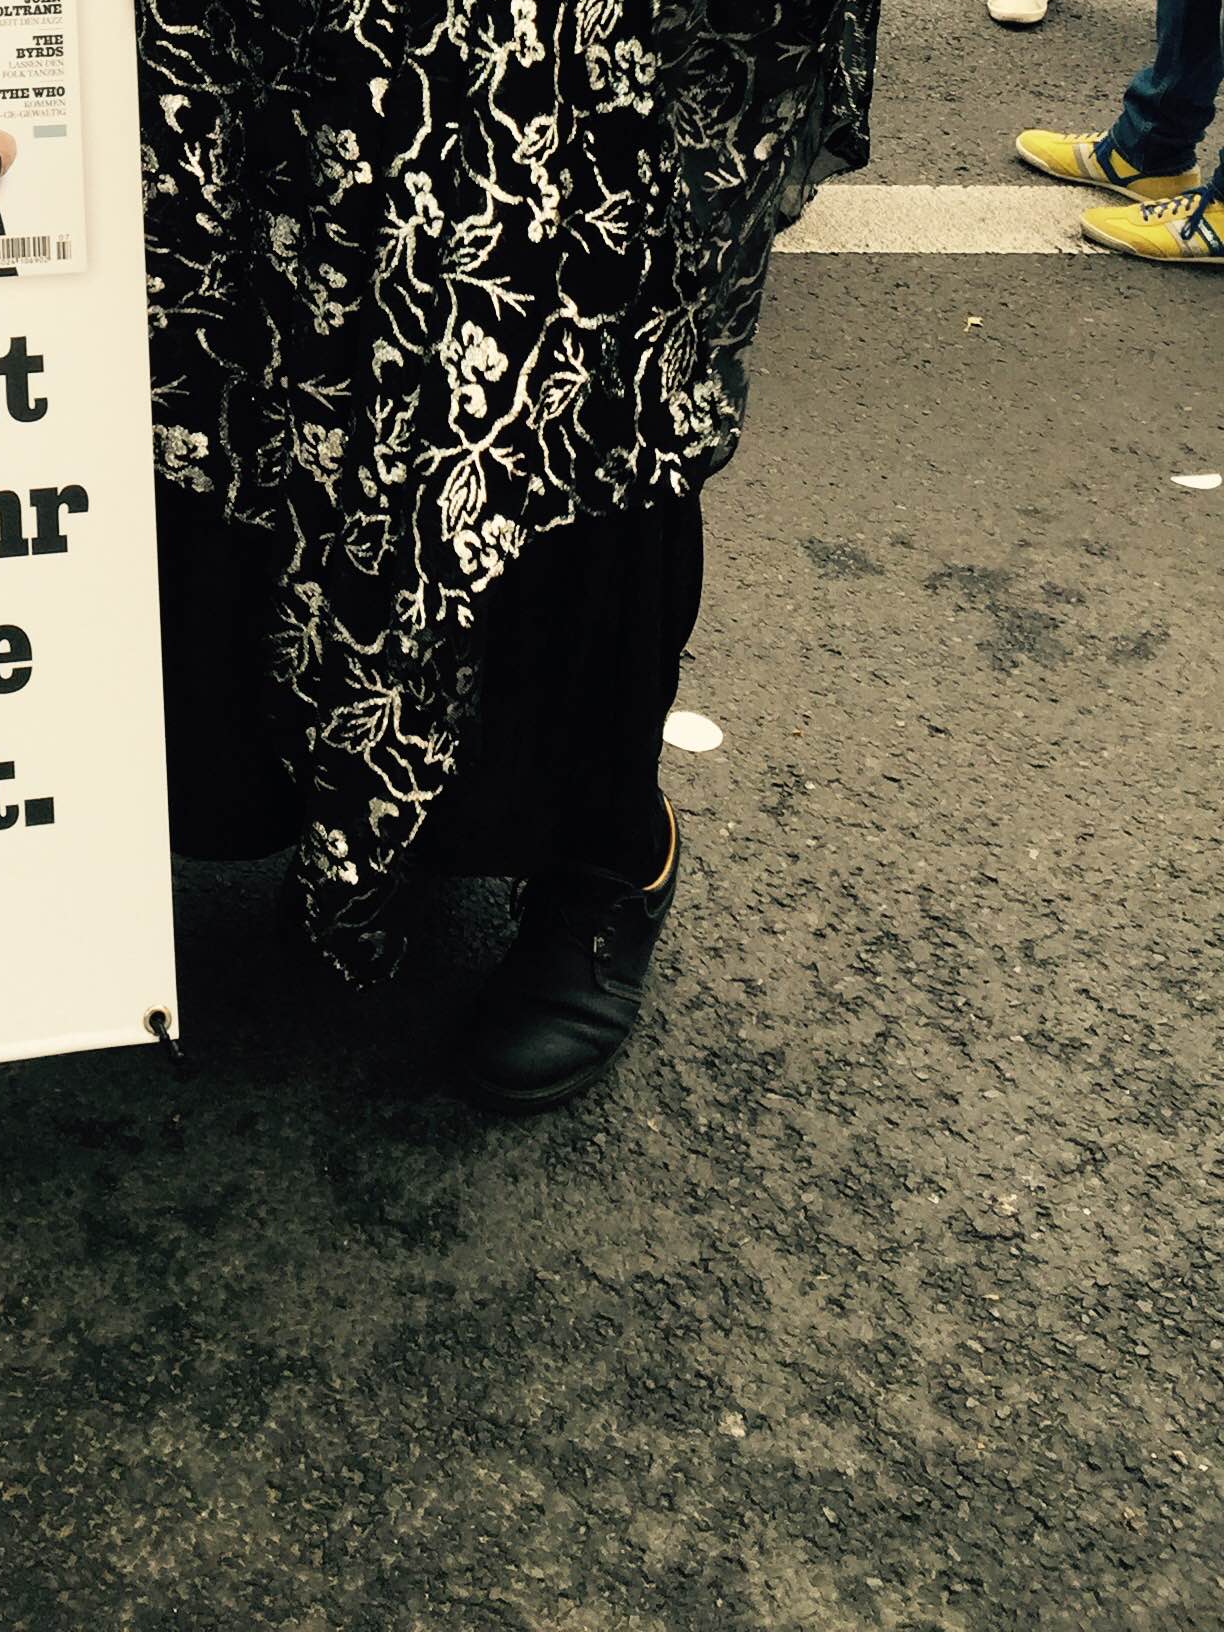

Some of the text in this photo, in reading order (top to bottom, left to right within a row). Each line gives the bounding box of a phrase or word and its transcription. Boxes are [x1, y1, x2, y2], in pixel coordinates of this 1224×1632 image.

[33, 35, 64, 46] THE
[16, 47, 64, 59] BYRDS
[0, 86, 65, 99] THE WHO
